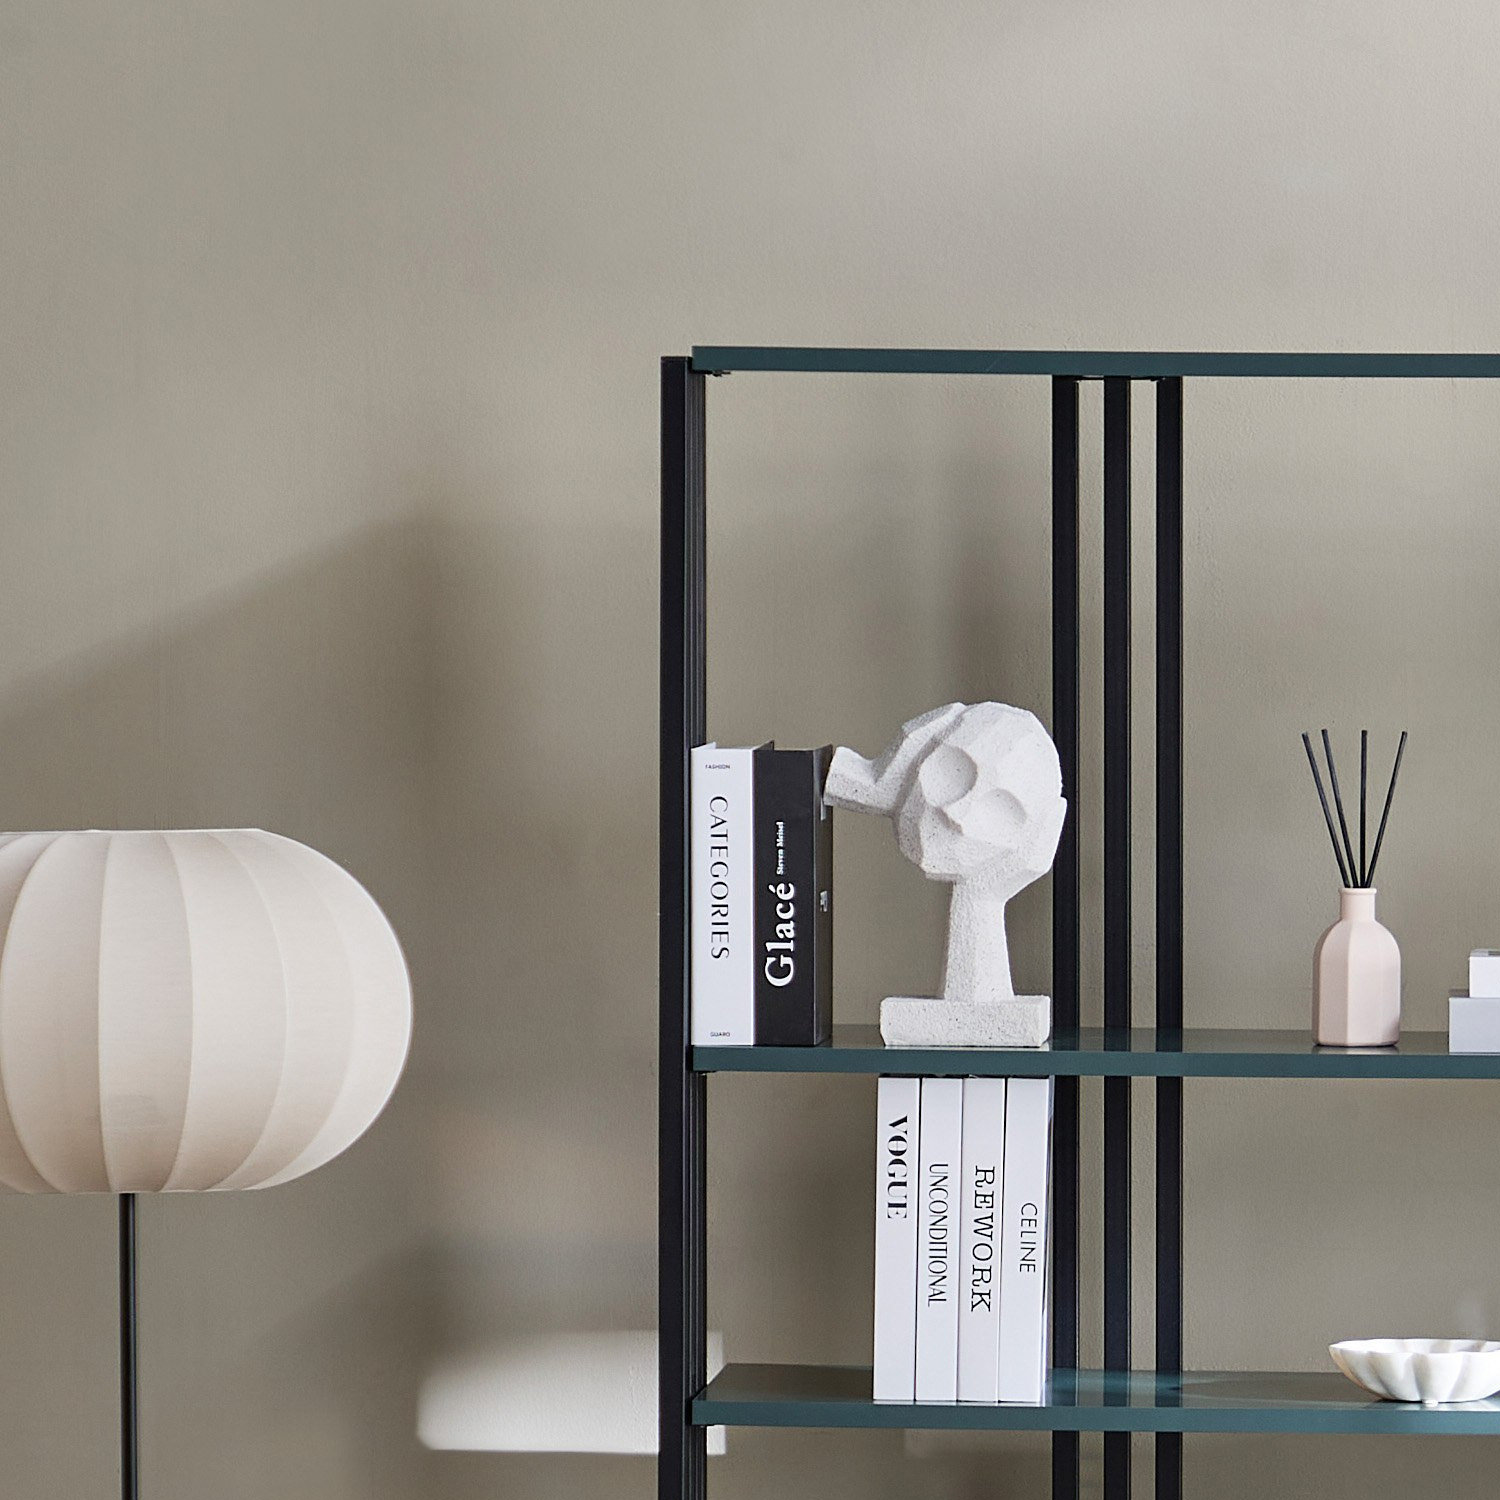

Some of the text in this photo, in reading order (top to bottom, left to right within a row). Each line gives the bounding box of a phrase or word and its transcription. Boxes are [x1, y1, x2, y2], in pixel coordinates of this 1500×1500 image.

[709, 795, 730, 960] CATEGORIES
[764, 882, 796, 988] Glacé
[887, 1115, 908, 1220] VOGUE
[927, 1163, 949, 1307] UNCONDITIONAL
[970, 1165, 996, 1313] REWORK
[1019, 1202, 1038, 1273] CELINE
